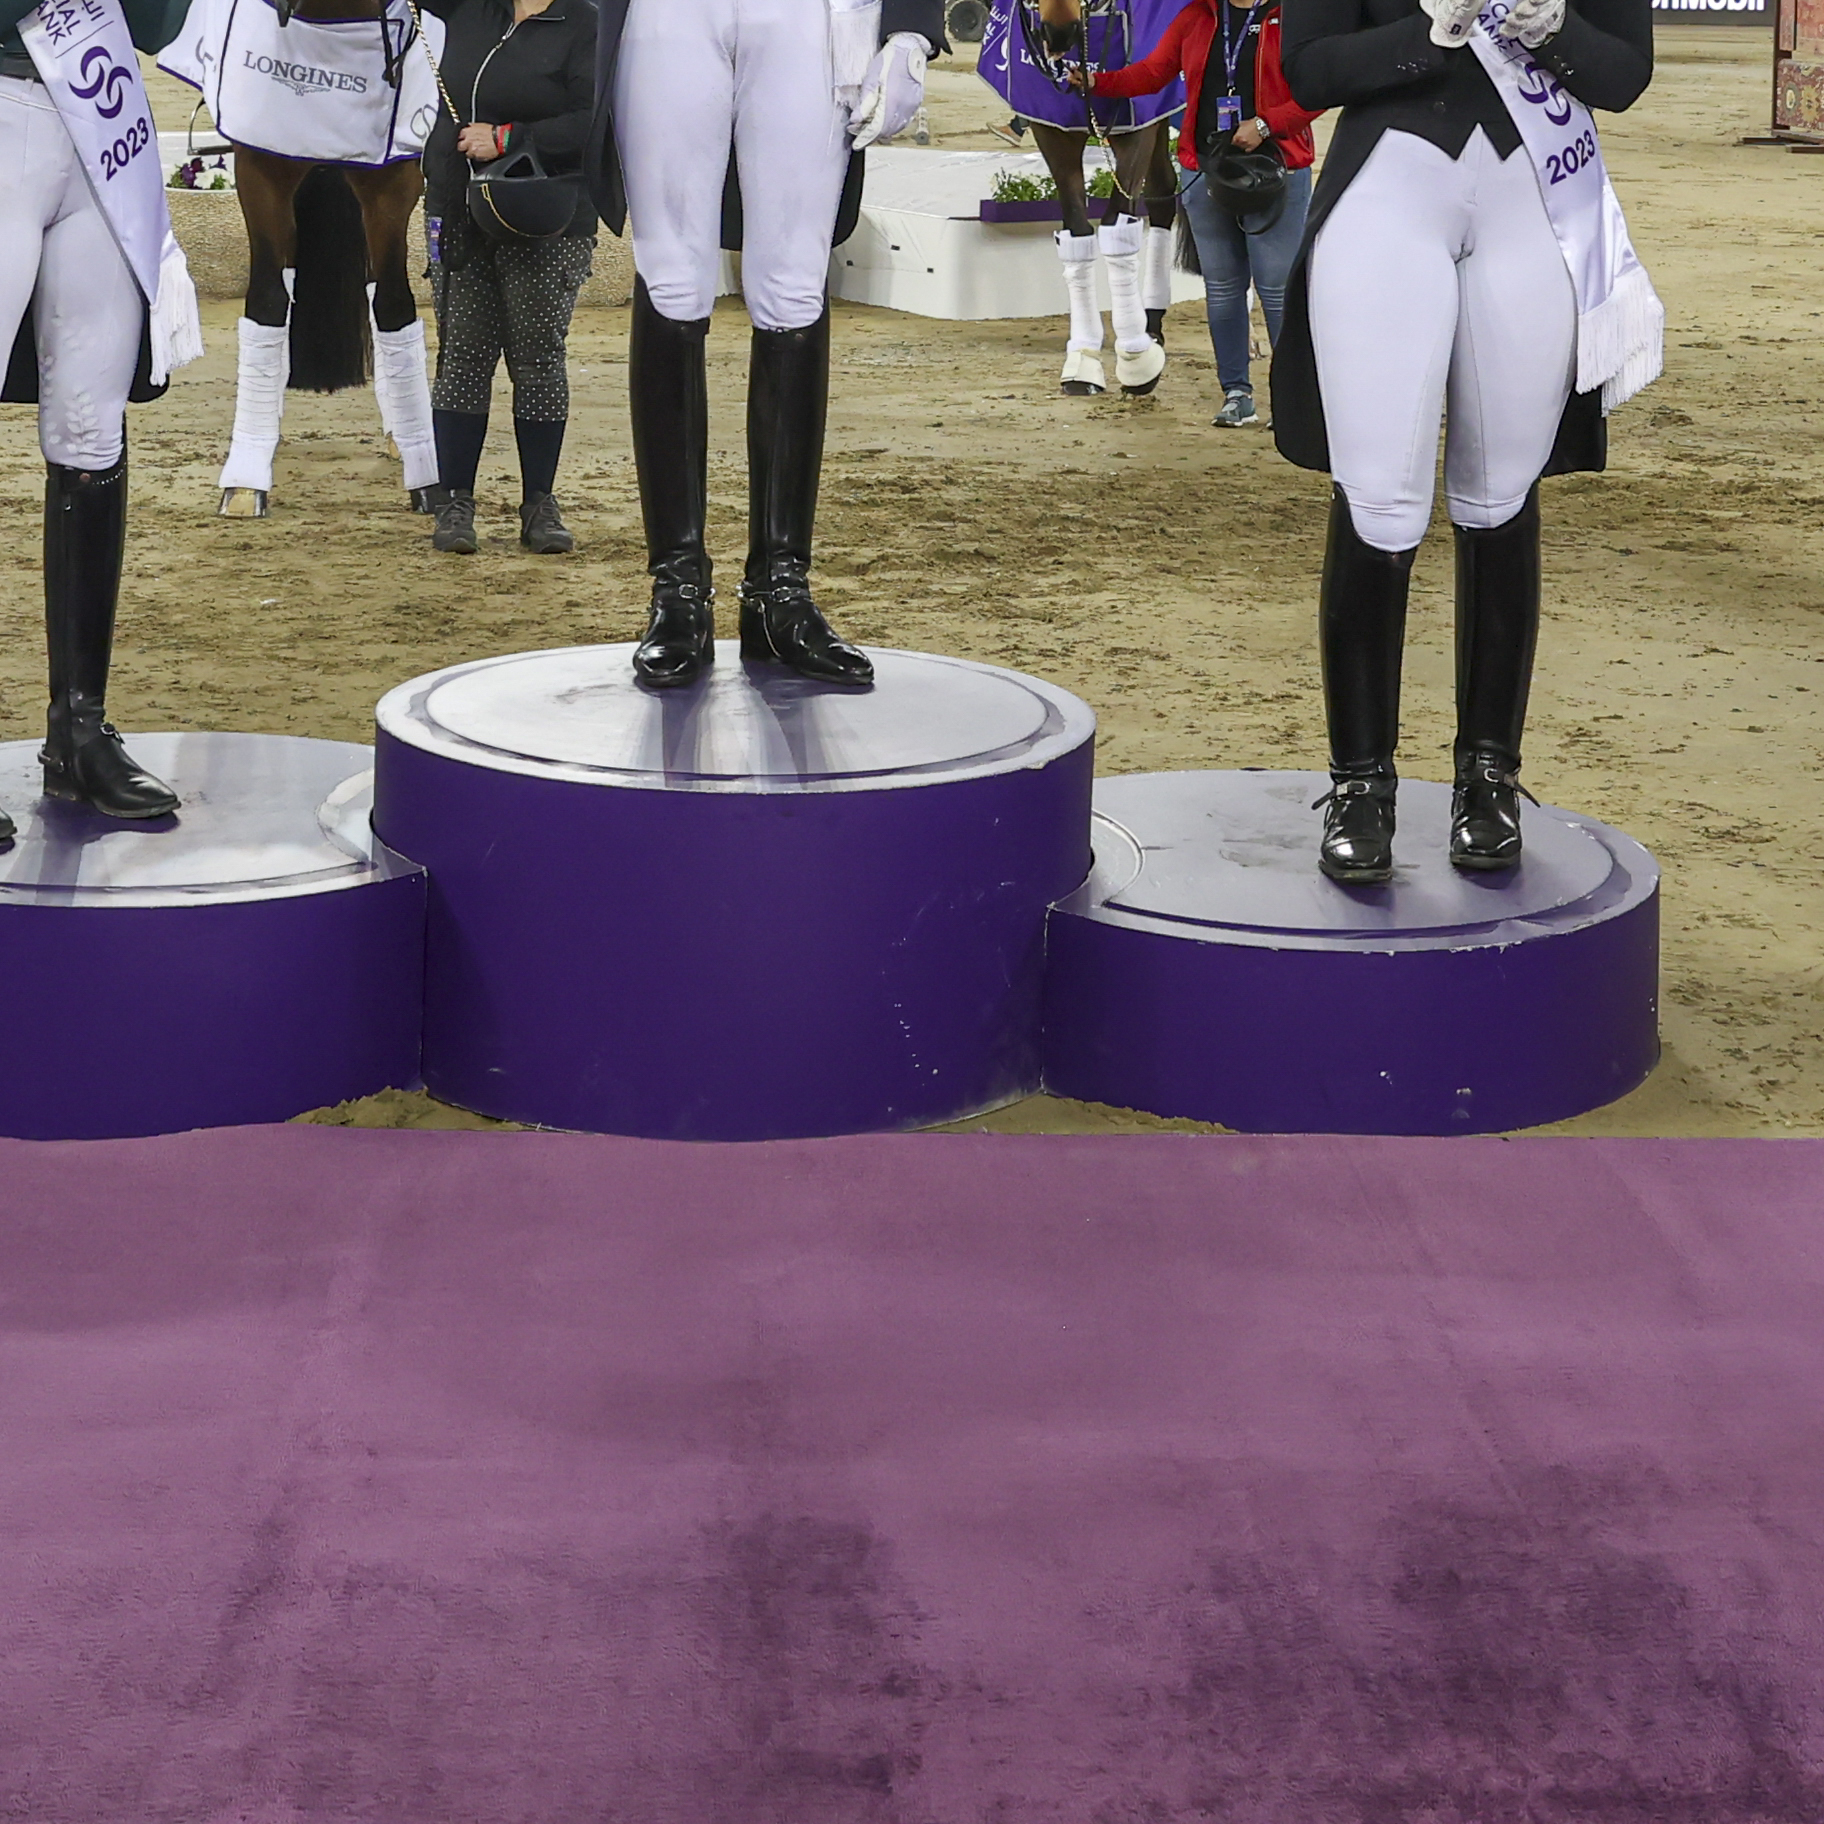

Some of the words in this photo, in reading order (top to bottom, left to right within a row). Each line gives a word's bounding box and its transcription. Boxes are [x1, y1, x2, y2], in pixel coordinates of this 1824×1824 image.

[243, 50, 368, 94] LONGINES
[100, 117, 149, 181] 2023
[1546, 130, 1596, 186] 2023
